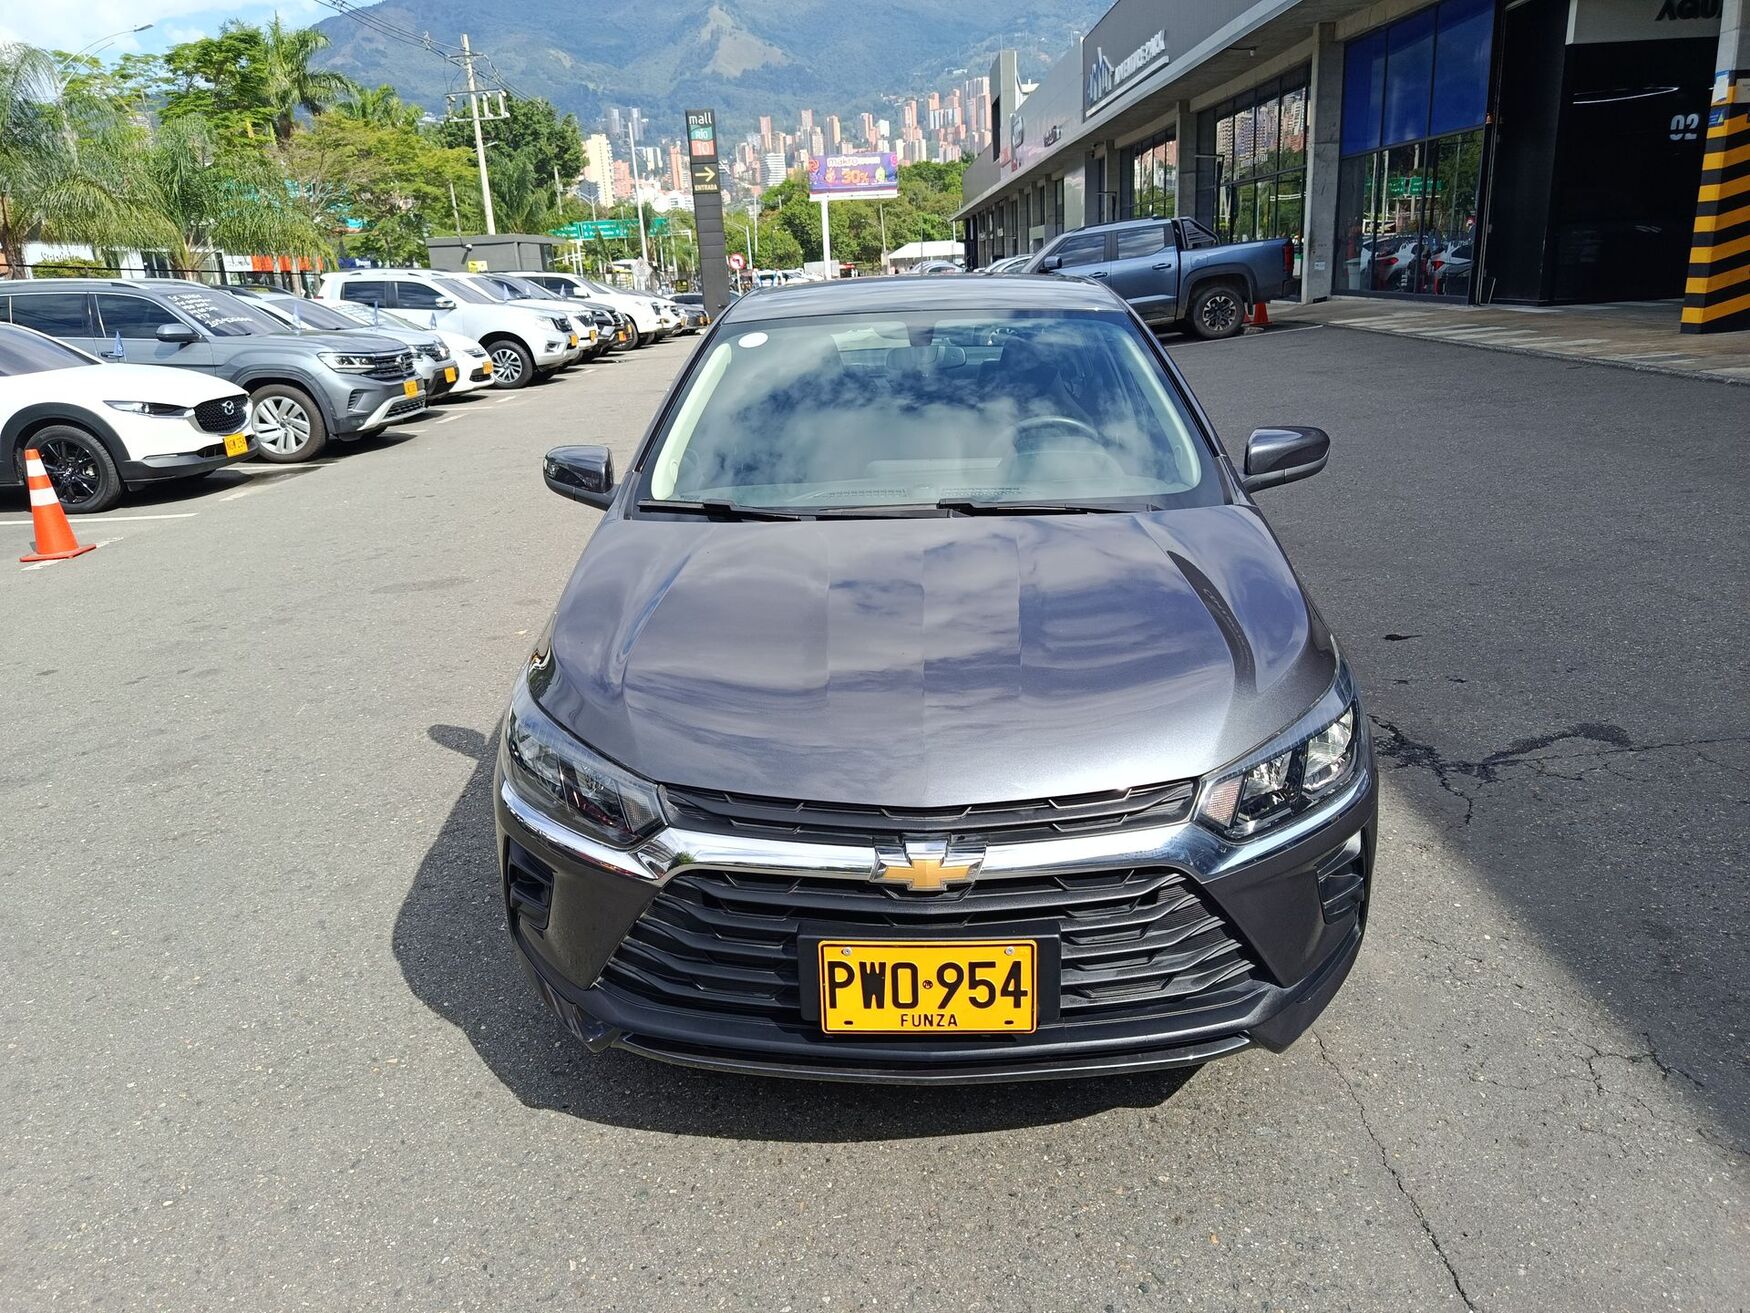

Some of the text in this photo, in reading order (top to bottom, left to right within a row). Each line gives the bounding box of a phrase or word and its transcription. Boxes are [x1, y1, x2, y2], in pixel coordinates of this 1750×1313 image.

[688, 112, 712, 125] mall
[1669, 113, 1699, 140] 02
[697, 143, 710, 155] 10
[827, 156, 859, 168] makro
[841, 168, 870, 184] 30%
[694, 183, 718, 192] ENTRADA
[899, 1012, 958, 1028] FUNZA
